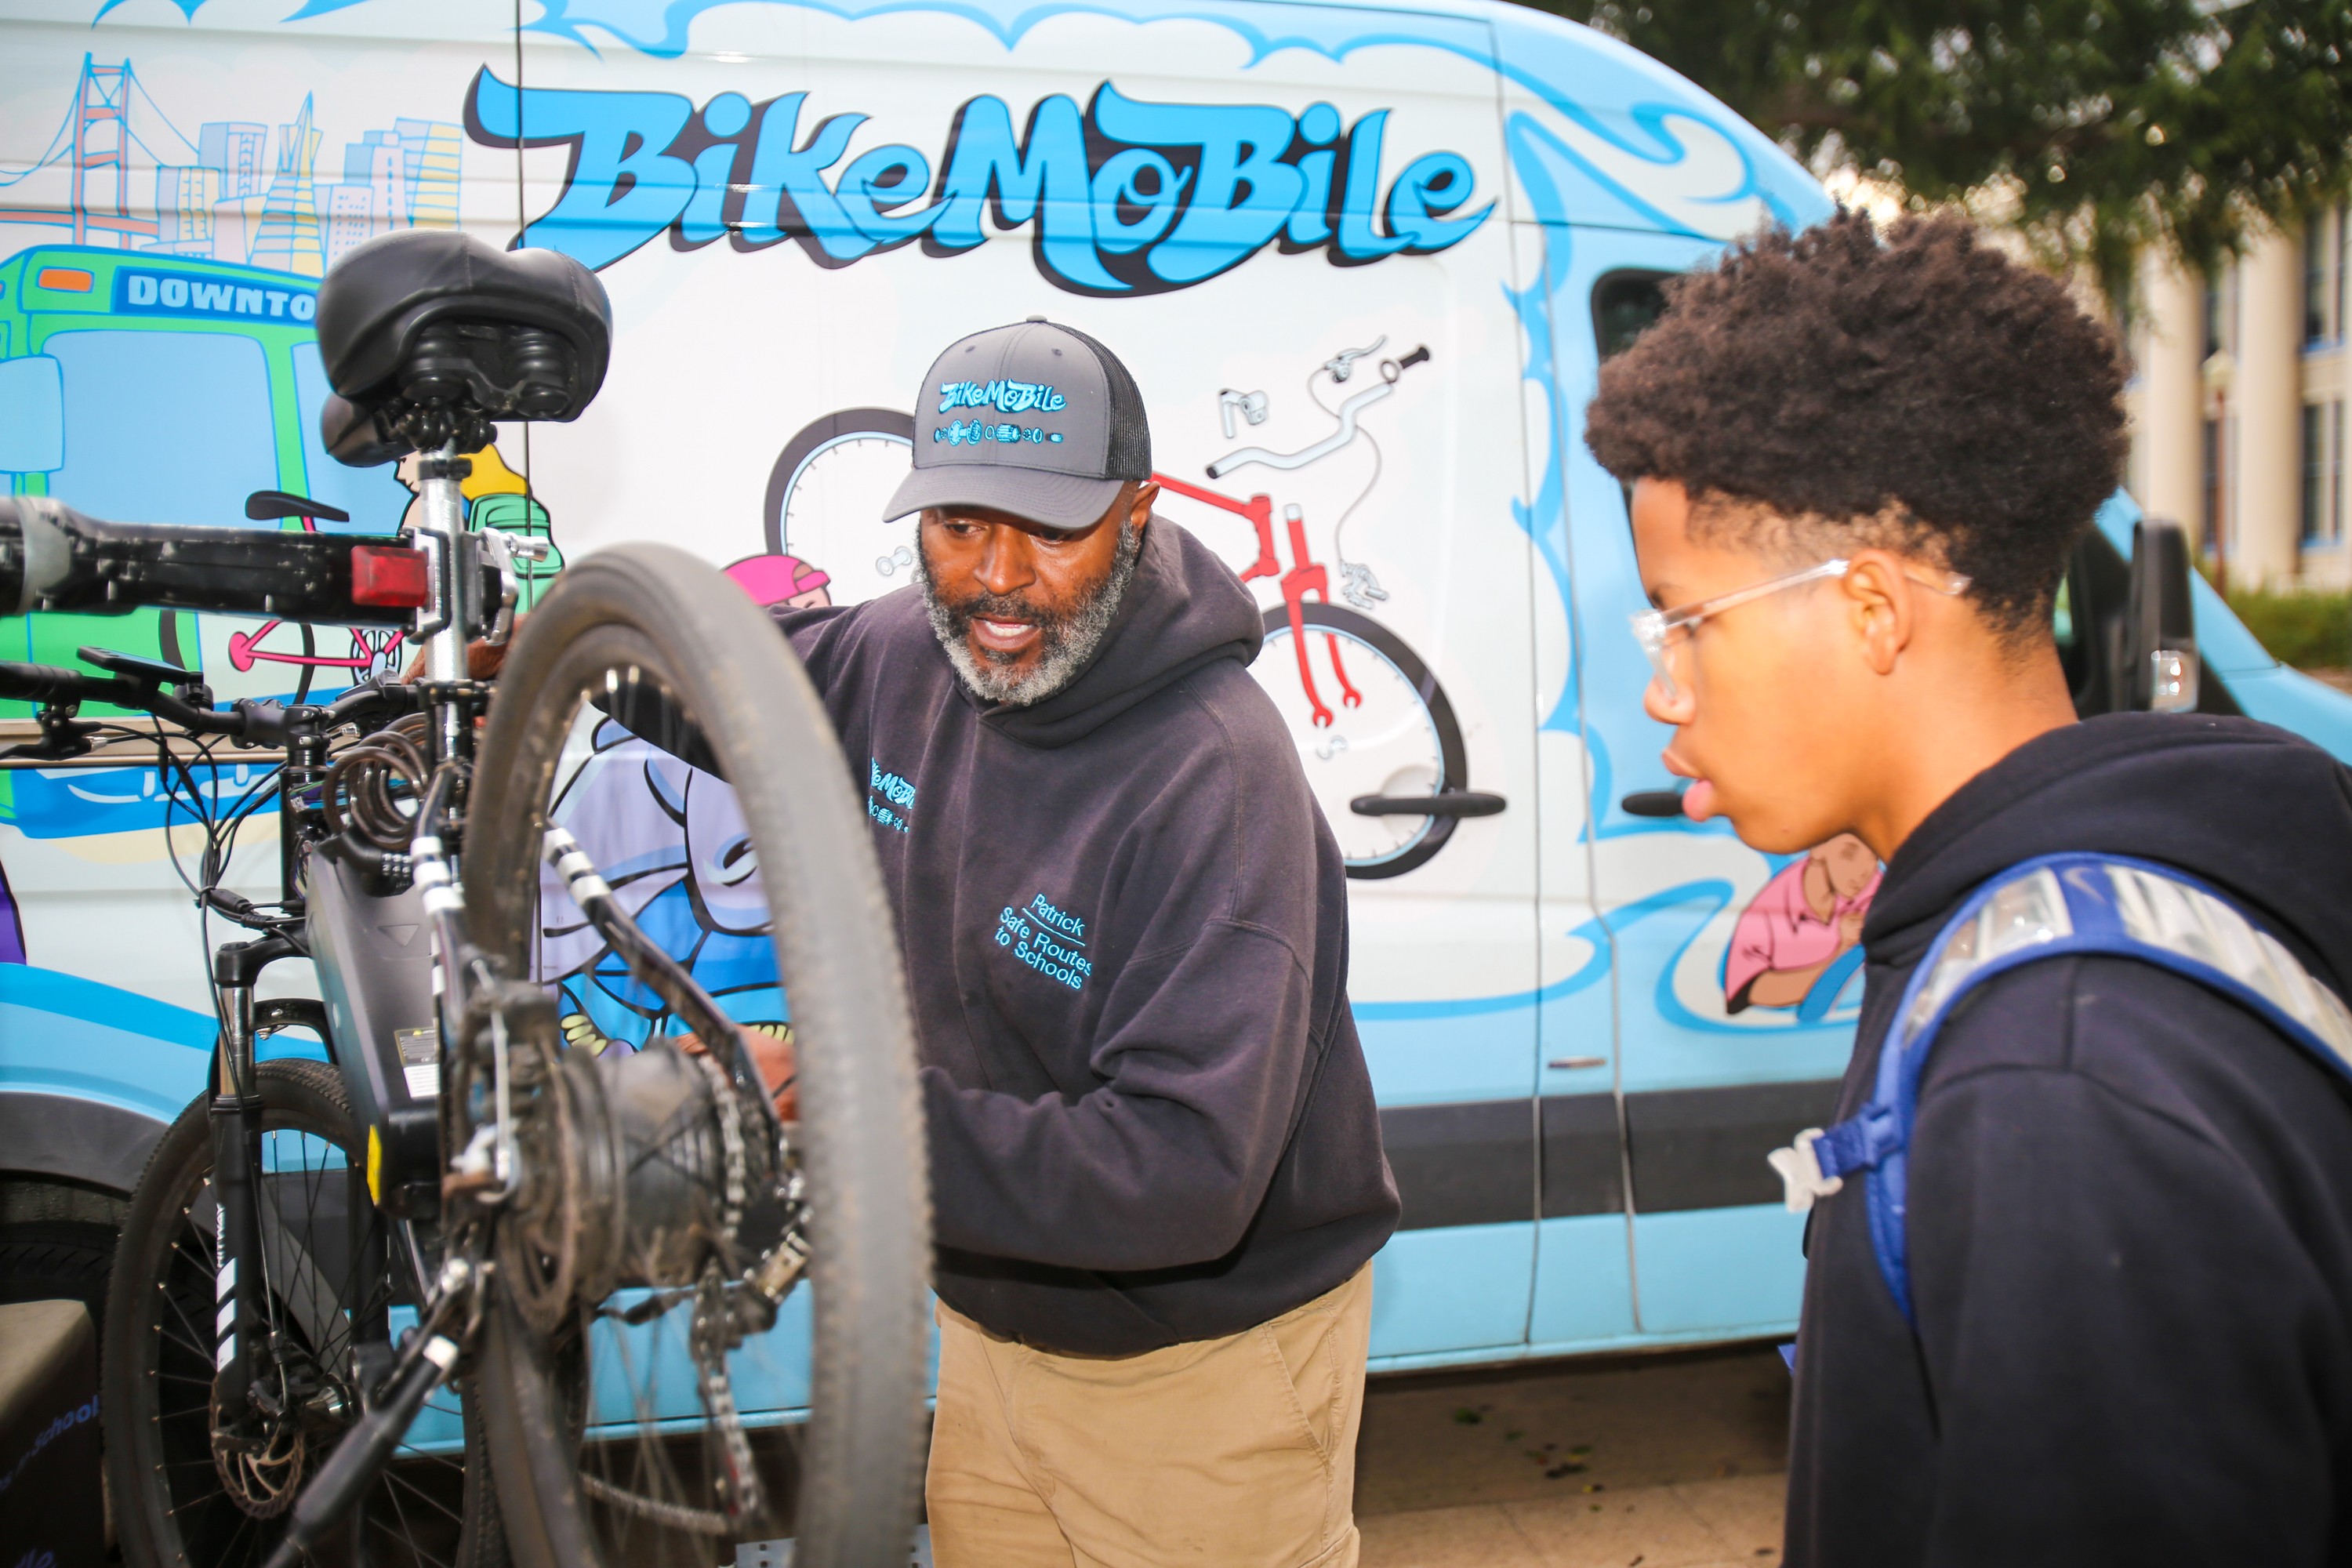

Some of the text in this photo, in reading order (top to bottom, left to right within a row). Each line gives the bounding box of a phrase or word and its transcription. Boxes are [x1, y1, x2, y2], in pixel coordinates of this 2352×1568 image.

[128, 274, 315, 321] DOWNTO
[1000, 906, 1091, 976] Safe Routes
[1030, 893, 1085, 936] Patrick
[994, 925, 1082, 989] to Schools
